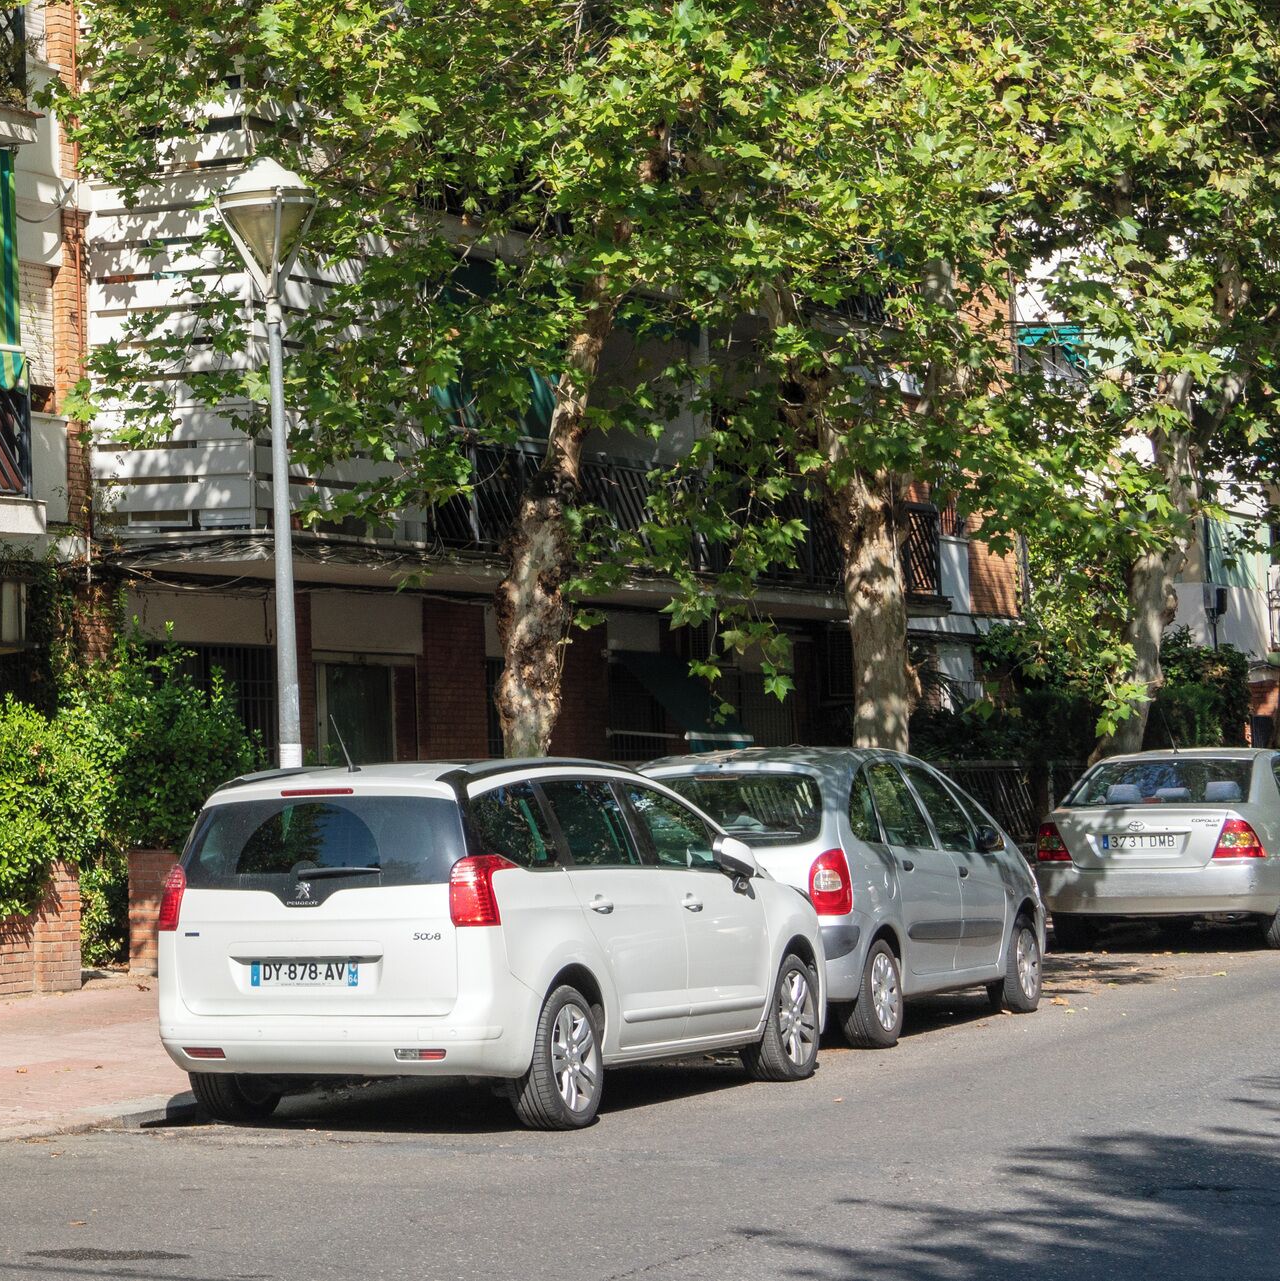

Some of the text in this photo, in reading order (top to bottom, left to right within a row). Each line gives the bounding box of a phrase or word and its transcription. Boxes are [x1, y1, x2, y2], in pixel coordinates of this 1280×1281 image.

[1111, 835, 1175, 848] 3731 DMB
[412, 932, 442, 941] 5008
[348, 974, 358, 983] 64
